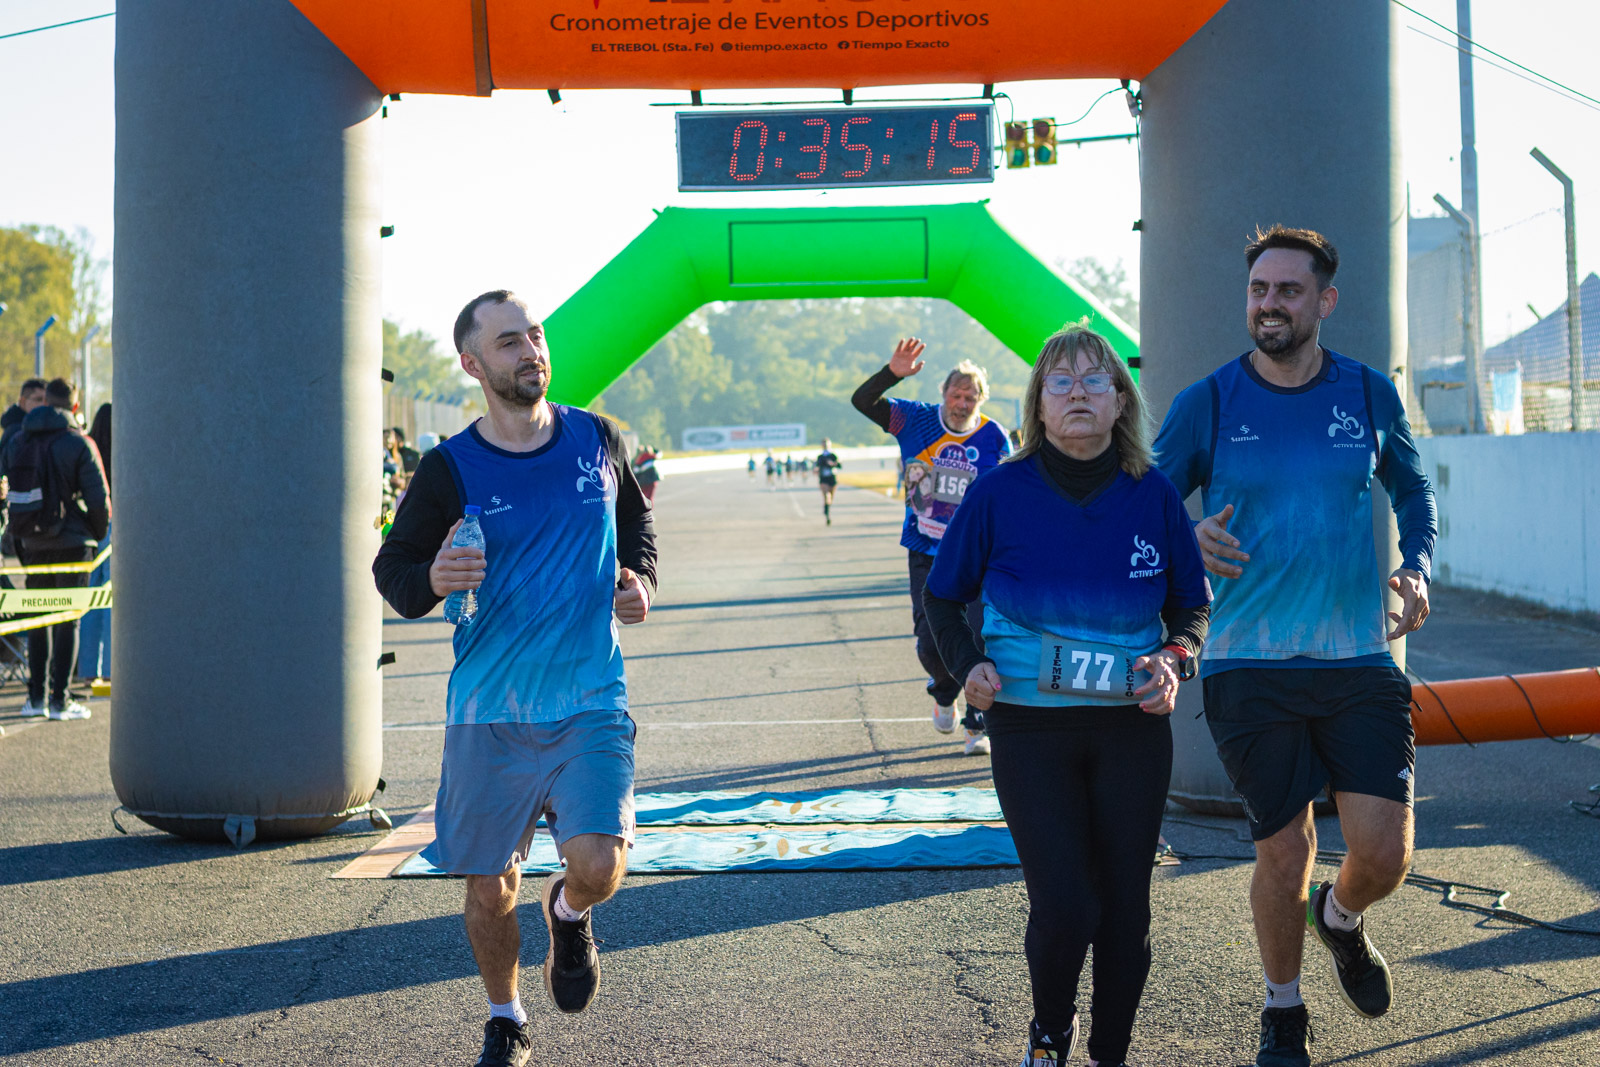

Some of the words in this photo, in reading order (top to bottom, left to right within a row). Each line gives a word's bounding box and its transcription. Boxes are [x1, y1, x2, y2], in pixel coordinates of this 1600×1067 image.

[550, 13, 711, 34] Cronometraje
[718, 12, 747, 30] de
[755, 12, 849, 30] Eventos
[856, 10, 989, 31] Deportivos
[591, 43, 606, 52] EL
[608, 43, 659, 52] TREBOL
[663, 43, 691, 53] (Sta.
[695, 42, 714, 52] Fe)
[735, 41, 828, 53] tiempo.exacto
[852, 40, 902, 51] Tiempo
[906, 40, 949, 49] Exacto
[938, 475, 968, 496] 156
[1129, 569, 1153, 579] ACTIVE
[21, 597, 72, 607] PRECAUCION
[1051, 645, 1063, 690] TIEMPO
[1071, 650, 1115, 691] 77
